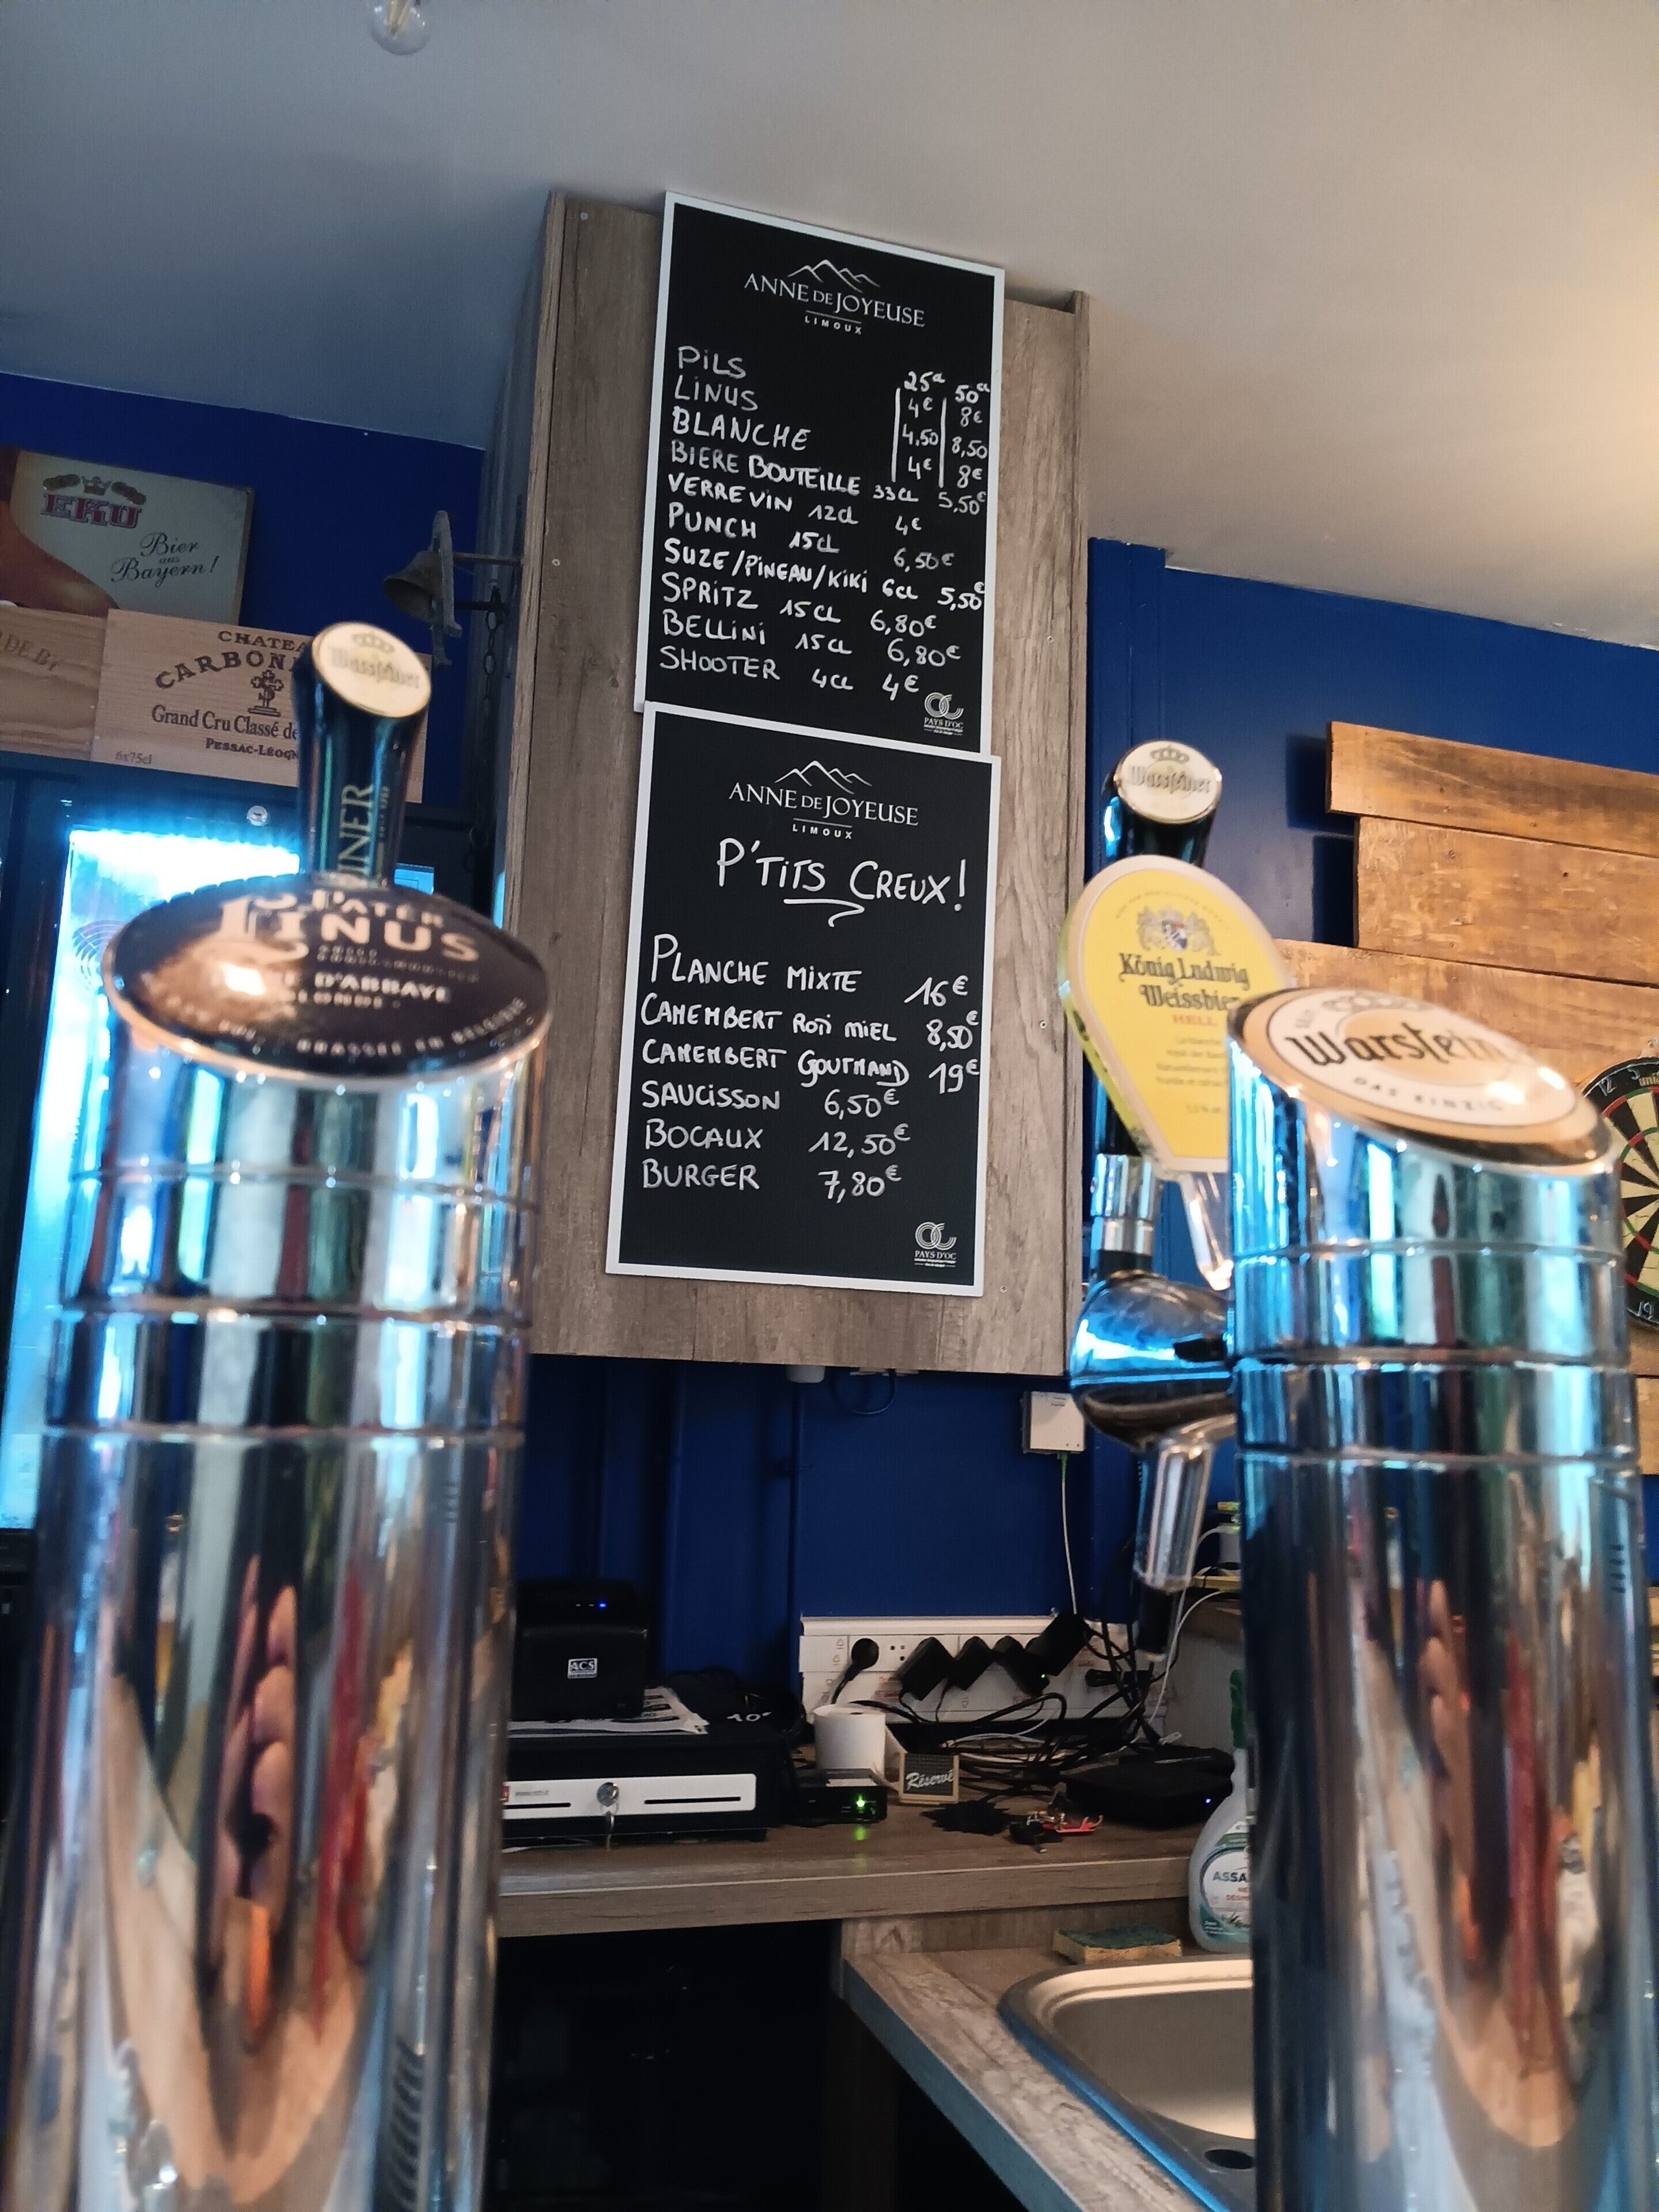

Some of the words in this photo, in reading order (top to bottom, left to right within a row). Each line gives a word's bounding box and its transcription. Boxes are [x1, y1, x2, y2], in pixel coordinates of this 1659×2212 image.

[744, 273, 809, 302] ANNE
[813, 289, 833, 306] DE
[834, 291, 926, 327] JOYEUSE
[804, 315, 862, 335] LIMOUX
[908, 397, 933, 419] 4€
[960, 406, 983, 427] 8€
[672, 406, 812, 452] BLANCHE
[902, 423, 939, 447] 4,50
[951, 436, 988, 460] 8,50
[748, 455, 861, 497] BOUTEILLE
[938, 490, 987, 516] 5,50€
[908, 456, 933, 480] 4€
[957, 465, 983, 489] 8€
[40, 491, 142, 529] EKU
[668, 473, 747, 503] VERRE
[894, 516, 922, 536] 4€
[140, 532, 199, 557] Bier
[668, 501, 756, 539] PUNCH
[893, 547, 956, 573] 6,50€
[937, 581, 986, 611] 5,50€
[870, 609, 937, 637] 6,80€
[887, 638, 962, 668] 6,80€
[659, 645, 780, 681] SHOOTER
[882, 673, 920, 701] 4€
[151, 704, 200, 728] Grand
[202, 710, 230, 732] Cru
[234, 715, 279, 738] Classé
[924, 717, 944, 726] PAYS
[728, 782, 797, 809] ANNE
[801, 794, 822, 810] DE
[823, 795, 919, 826] JOYEUSE
[793, 824, 853, 840] LIMOUX
[650, 933, 769, 986] PLANCHE
[904, 976, 969, 1006] 16€
[640, 992, 783, 1030] CAMEMBERT
[925, 1010, 979, 1052] 8,50€
[642, 1039, 787, 1069] CAMEMBERT
[797, 1049, 910, 1088] GOURMAND
[928, 1058, 980, 1094] 19€
[824, 1089, 900, 1119] 6,50€
[645, 1118, 764, 1150] BOCAUX
[808, 1123, 911, 1159] 12,50€
[641, 1158, 760, 1191] BURGER
[817, 1165, 903, 1204] 7,80€
[915, 1250, 935, 1259] PAYS
[936, 1252, 957, 1260] D'OC
[570, 1660, 594, 1671] ACS
